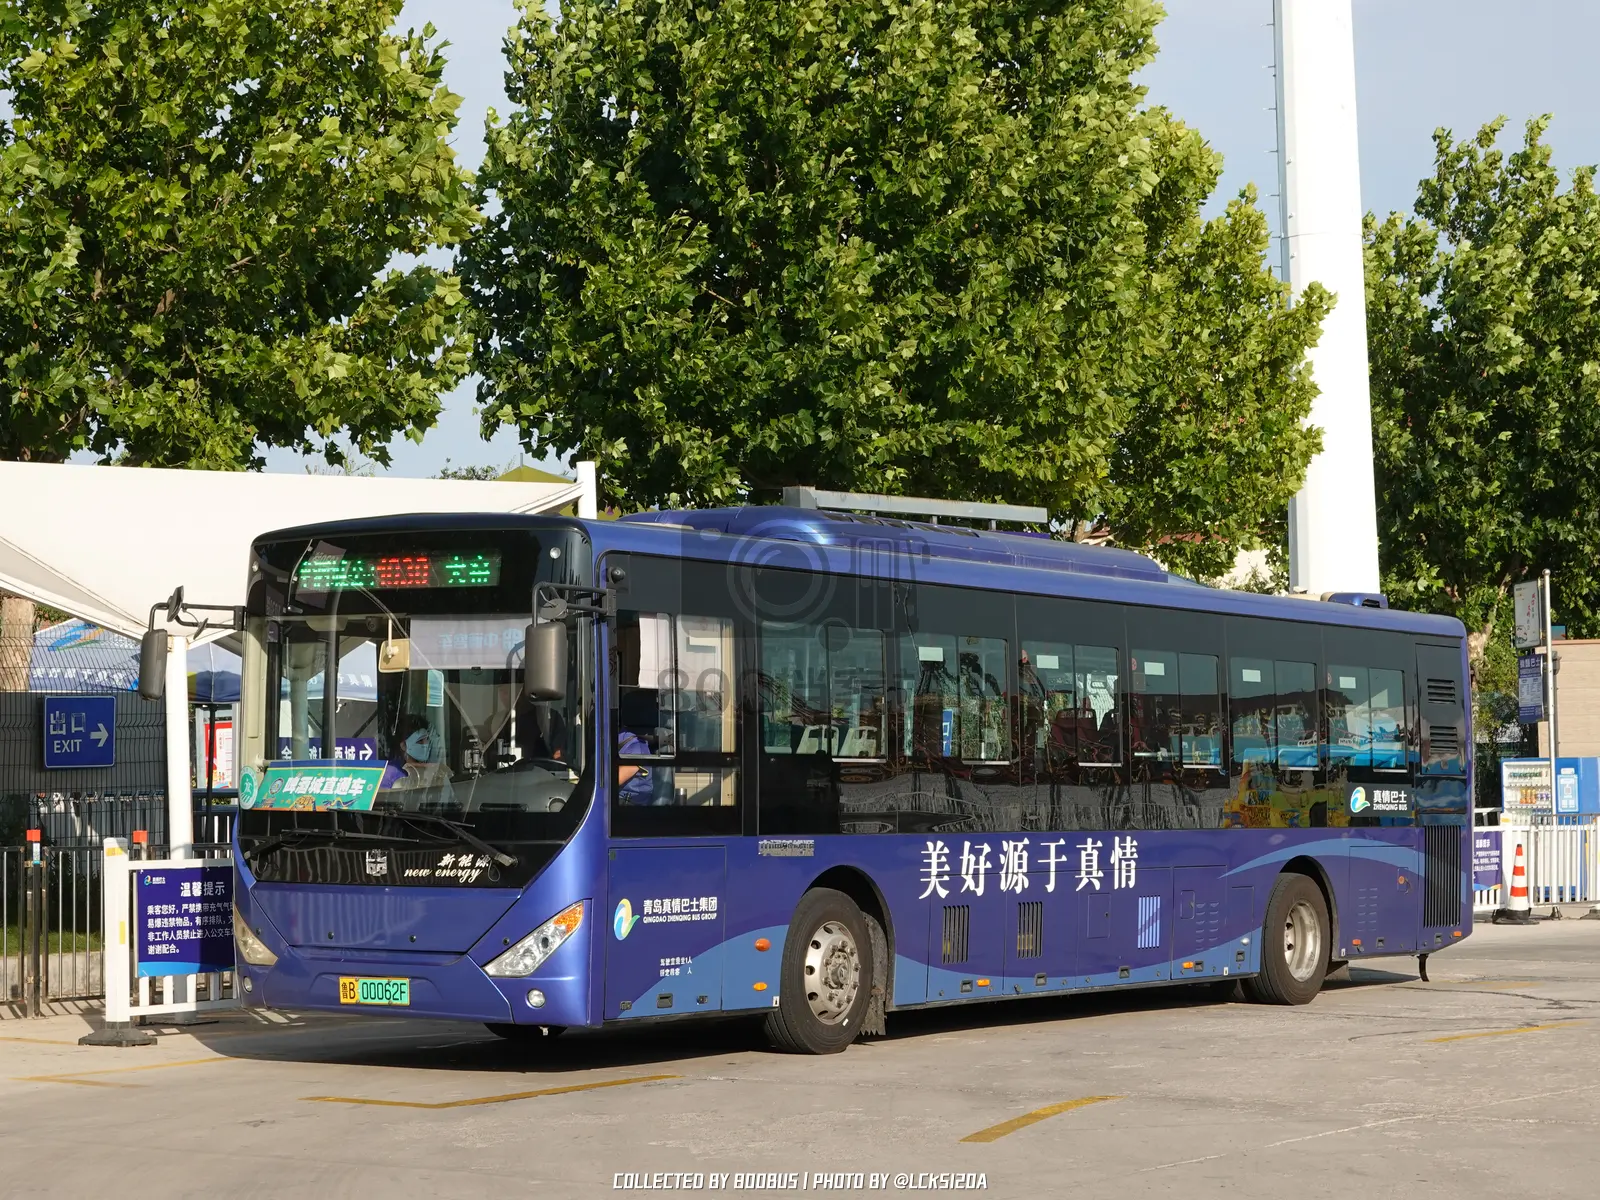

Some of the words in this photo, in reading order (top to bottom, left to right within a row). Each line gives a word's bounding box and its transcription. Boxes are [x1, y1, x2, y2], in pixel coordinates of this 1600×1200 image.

[50, 711, 86, 735] 出口
[53, 739, 83, 754] EXIT
[282, 775, 367, 796] 啤酒城直通车
[1373, 789, 1408, 803] 真情巴士
[1373, 803, 1398, 811] ZHENQING
[1398, 803, 1408, 811] BUS
[437, 853, 491, 868] 新能源
[918, 835, 1140, 900] 美好源于真情
[403, 867, 432, 878] new
[434, 867, 484, 884] energy
[180, 881, 225, 897] 温馨提示
[643, 897, 718, 915] 青岛真情巴士集团
[643, 915, 667, 924] QINGDAO
[692, 913, 701, 921] BUS
[701, 912, 717, 921] GROUP
[361, 981, 407, 1001] 00062F
